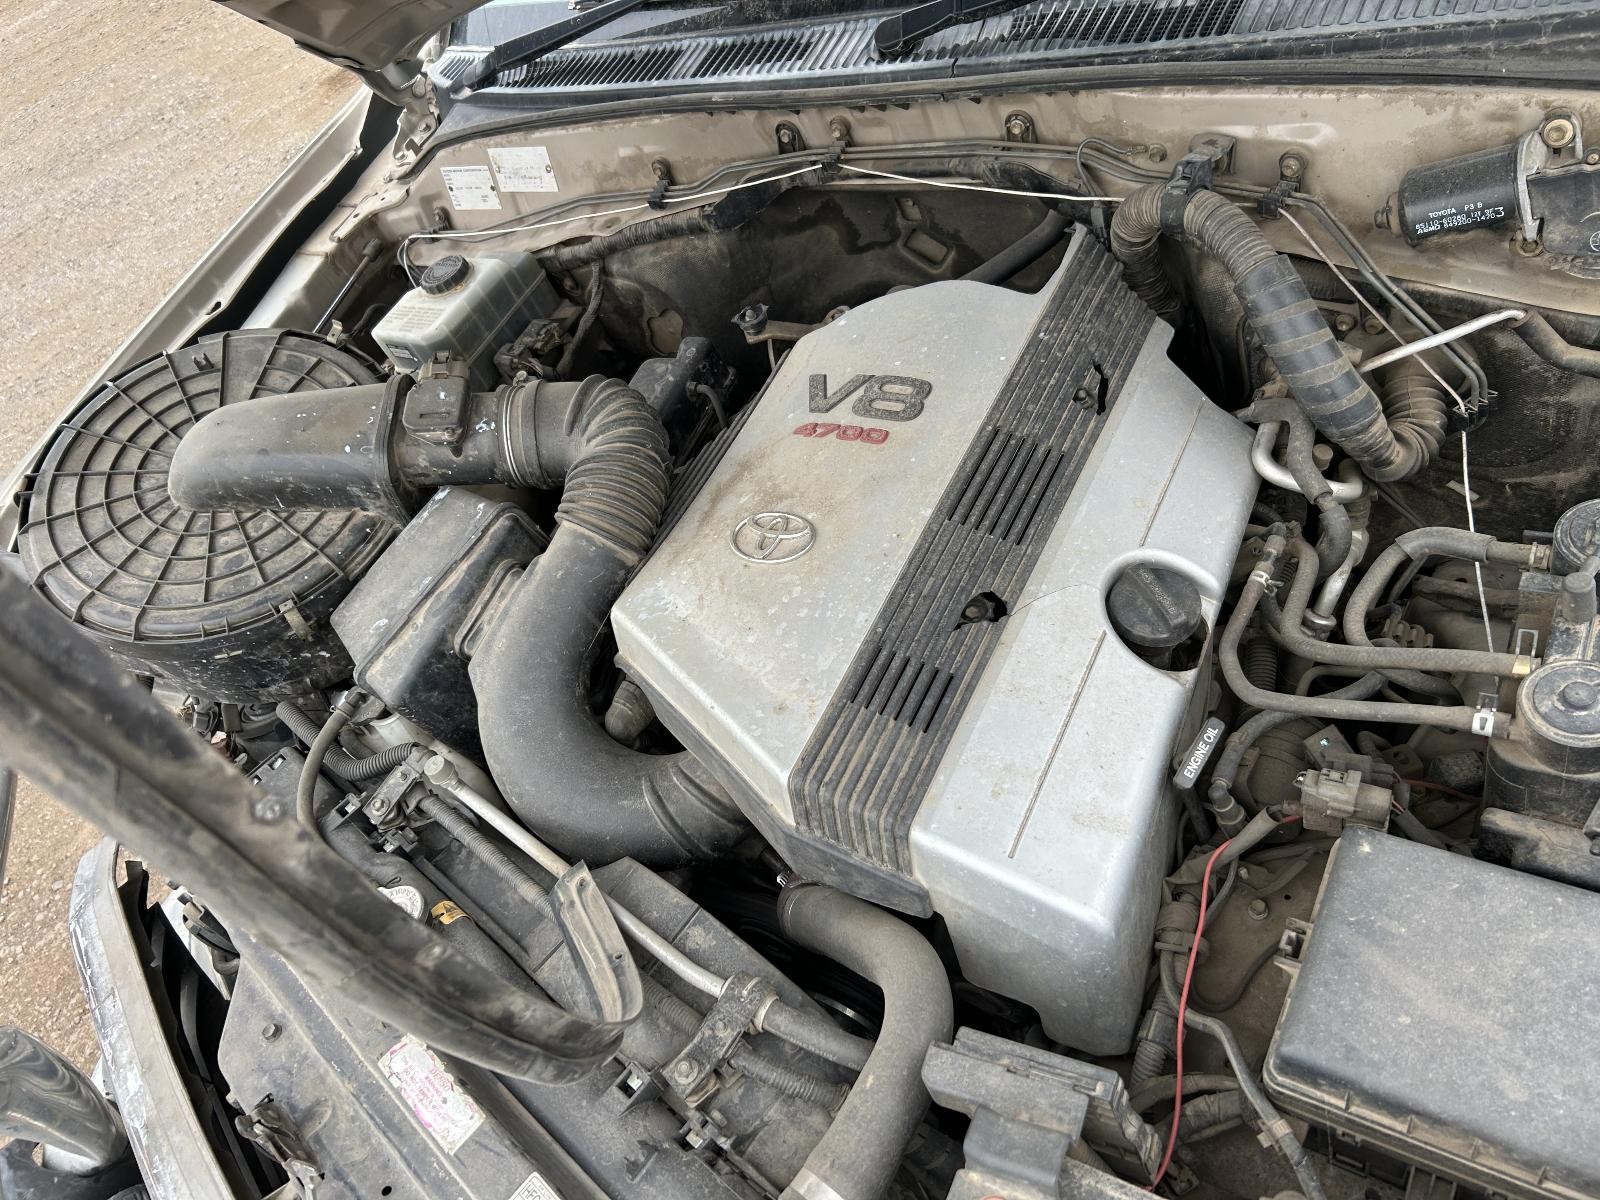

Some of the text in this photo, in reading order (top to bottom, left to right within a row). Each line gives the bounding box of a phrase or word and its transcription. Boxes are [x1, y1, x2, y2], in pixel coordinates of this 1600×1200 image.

[1428, 207, 1457, 219] TOYOTA
[1494, 206, 1505, 218] 3
[808, 373, 933, 422] V8
[793, 422, 890, 444] 4700
[1183, 727, 1219, 779] ENGINE OIL
